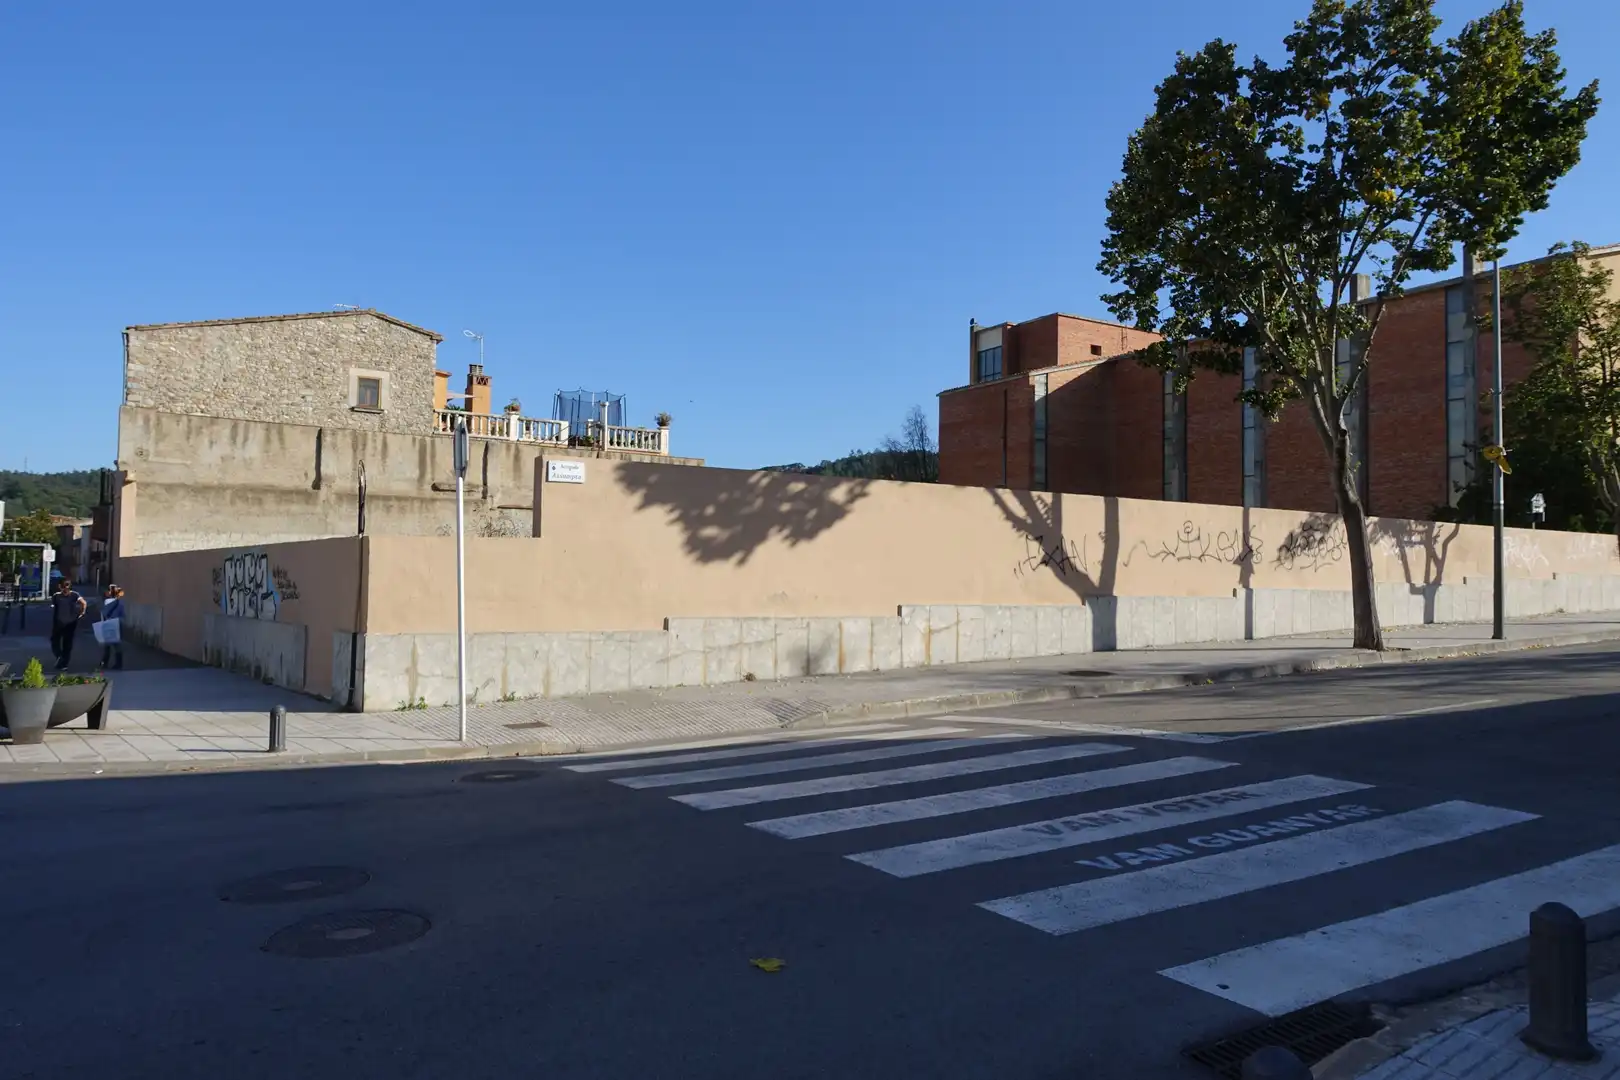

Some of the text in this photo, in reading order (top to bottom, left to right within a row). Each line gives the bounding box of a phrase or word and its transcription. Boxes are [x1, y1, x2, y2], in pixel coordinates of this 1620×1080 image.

[1022, 789, 1266, 836] VAM VOTAR
[1073, 803, 1386, 870] VAM GUANYAR
